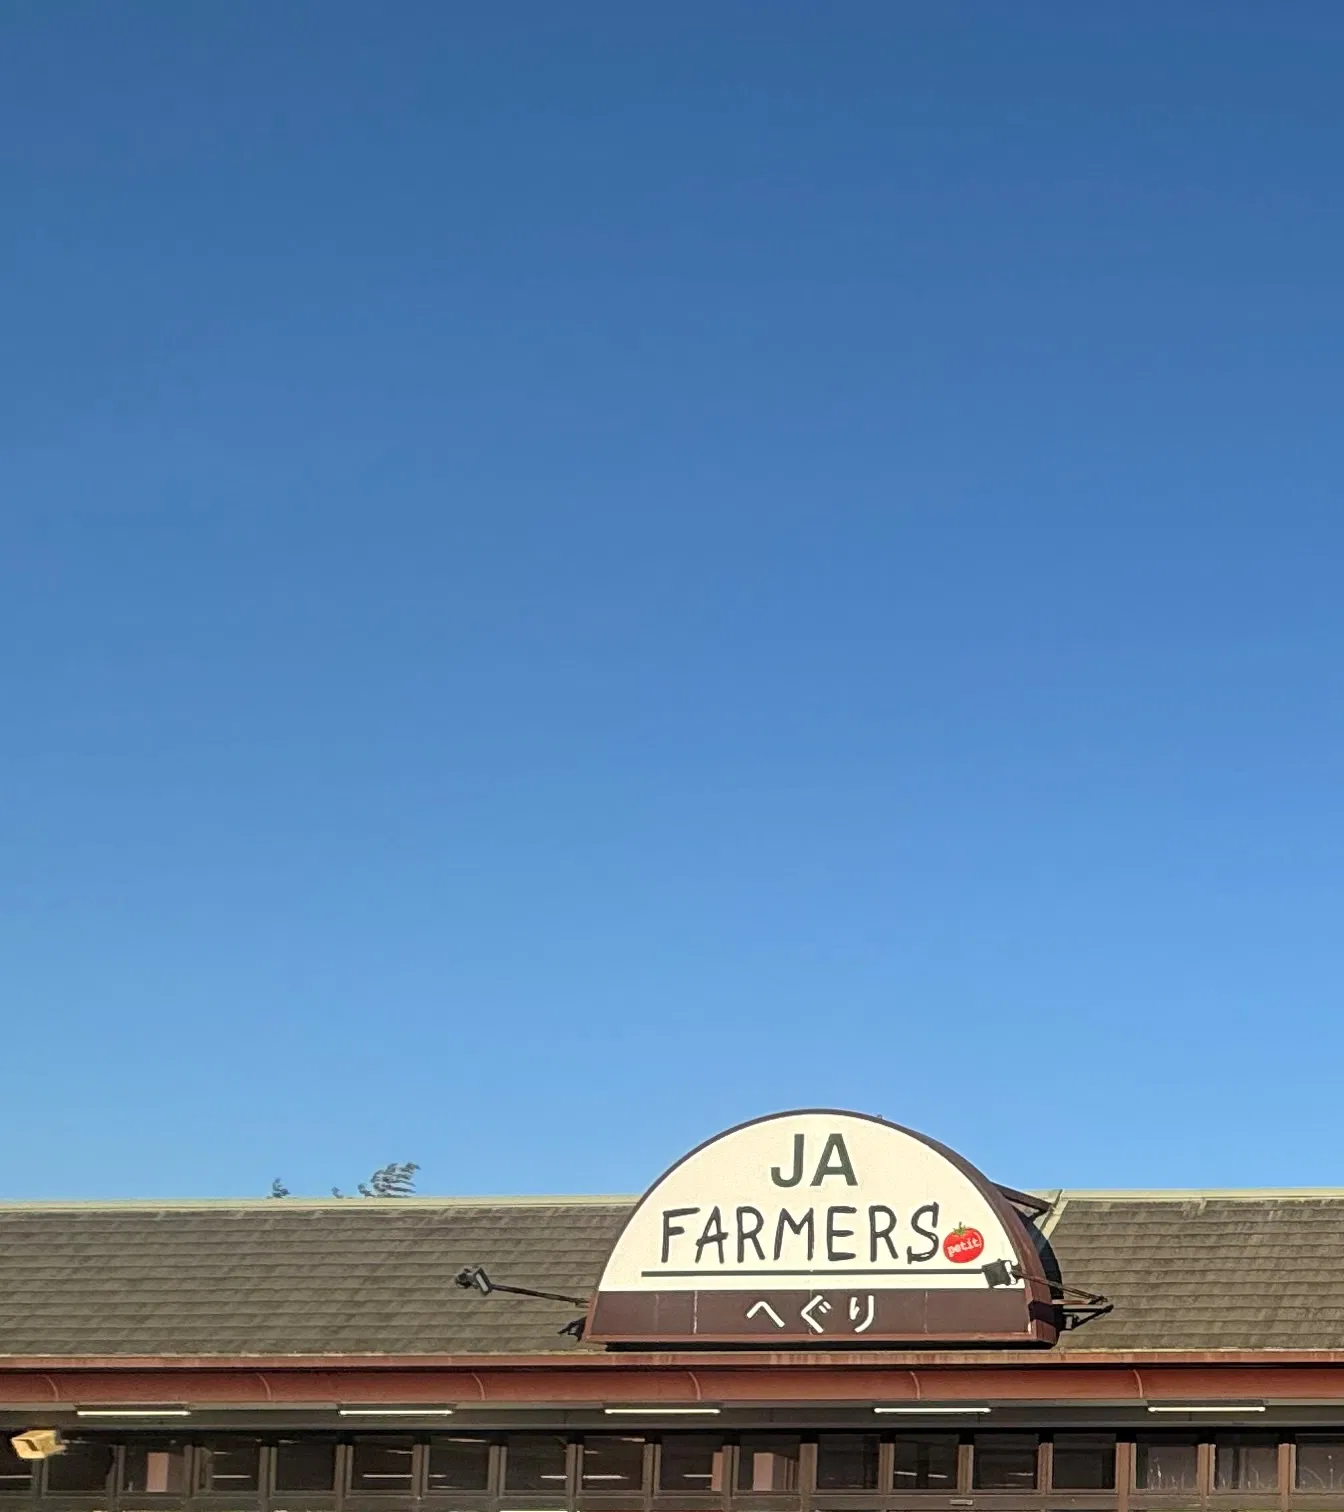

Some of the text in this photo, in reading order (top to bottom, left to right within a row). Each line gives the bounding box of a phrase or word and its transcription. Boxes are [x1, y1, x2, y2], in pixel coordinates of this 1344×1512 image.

[770, 1133, 859, 1188] JA
[660, 1201, 940, 1264] FARMERS
[946, 1237, 979, 1258] petit
[746, 1294, 875, 1334] へぐり
